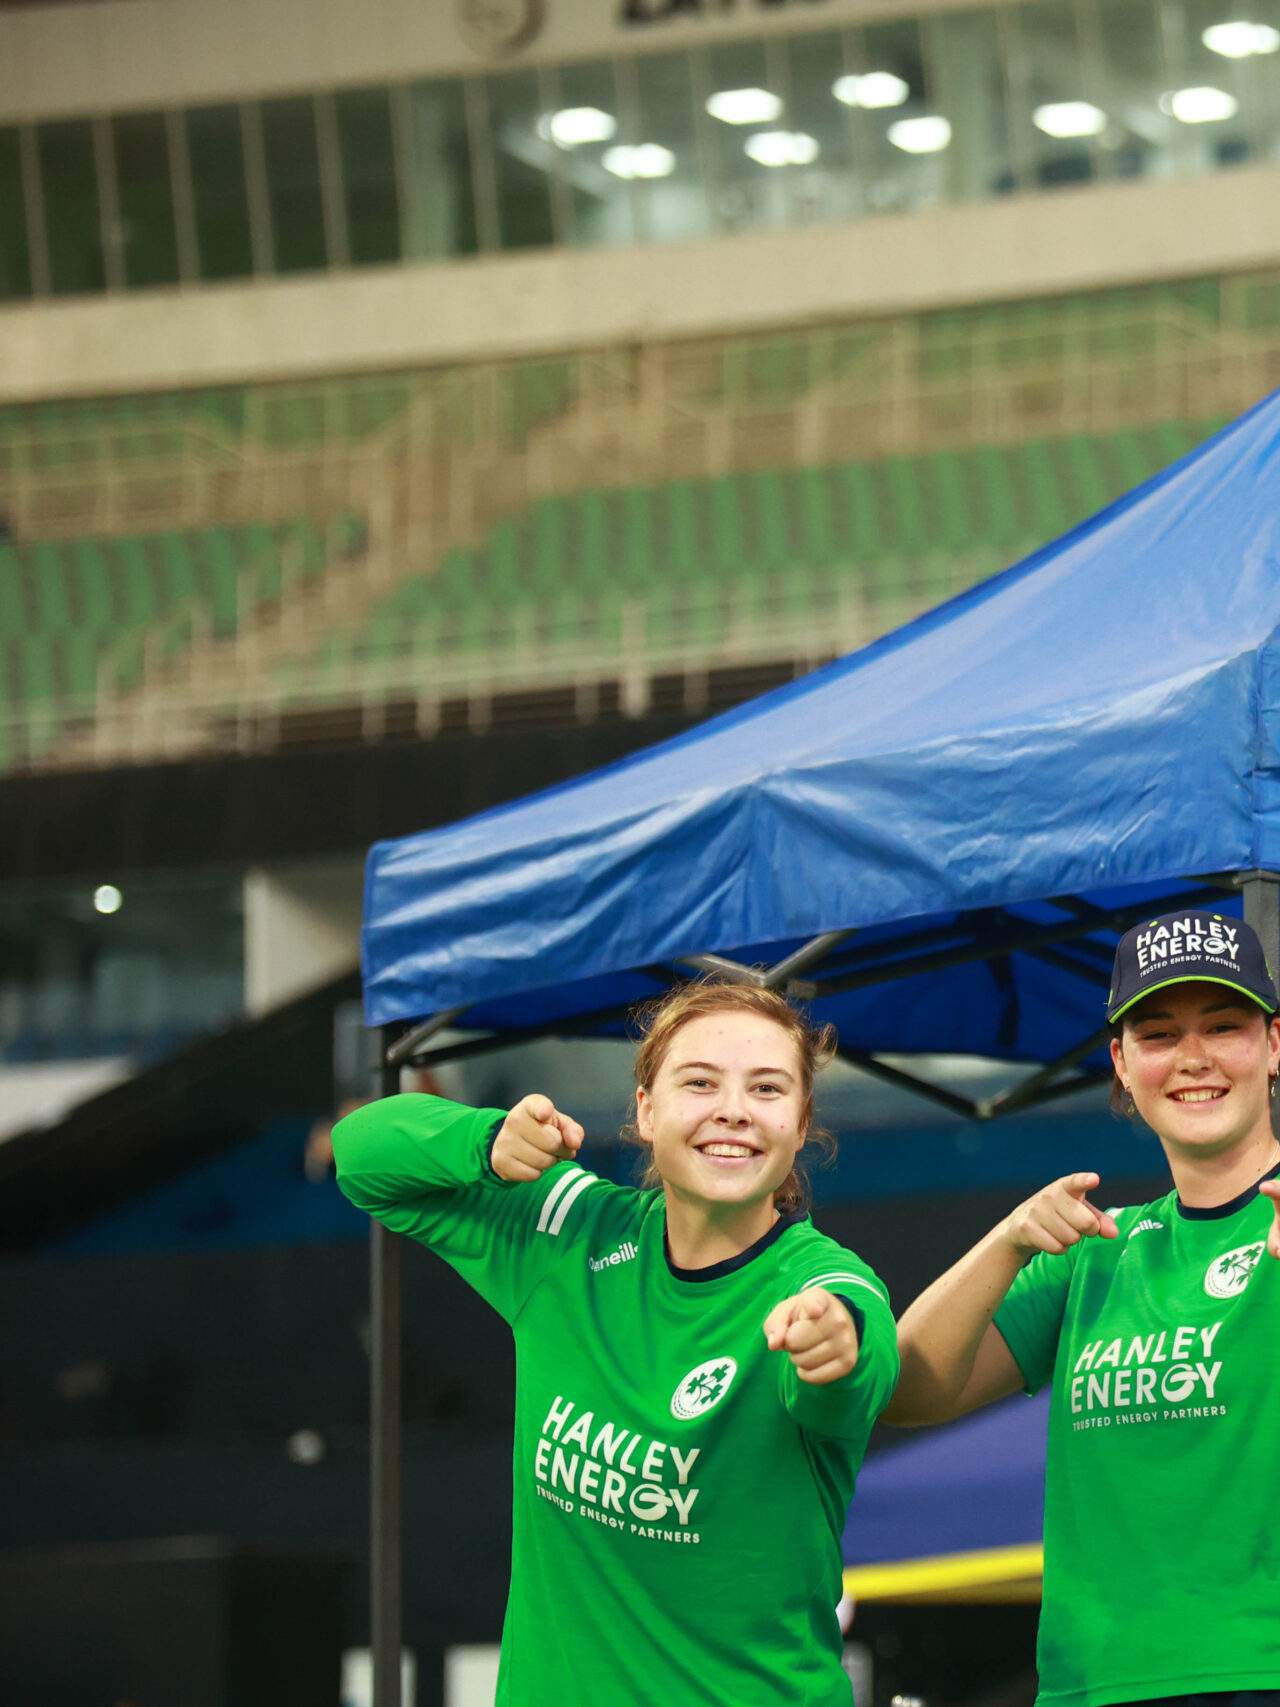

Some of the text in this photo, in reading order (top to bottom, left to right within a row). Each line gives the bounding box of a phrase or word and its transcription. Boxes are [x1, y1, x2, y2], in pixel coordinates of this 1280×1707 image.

[1136, 918, 1237, 950] HANLEY
[1137, 934, 1240, 969] ENERGY
[1139, 954, 1241, 978] TRUSTED ENERGY PARTNERS
[1073, 1321, 1224, 1374] HANLEY
[1071, 1361, 1224, 1414] ENERGY
[1072, 1405, 1227, 1432] TRUSTED ENERGY PARTNERS
[541, 1395, 701, 1485] HANLEY
[535, 1437, 700, 1526] ENERGY
[580, 1505, 625, 1531] ENERGY
[630, 1523, 700, 1544] PARTNERS
